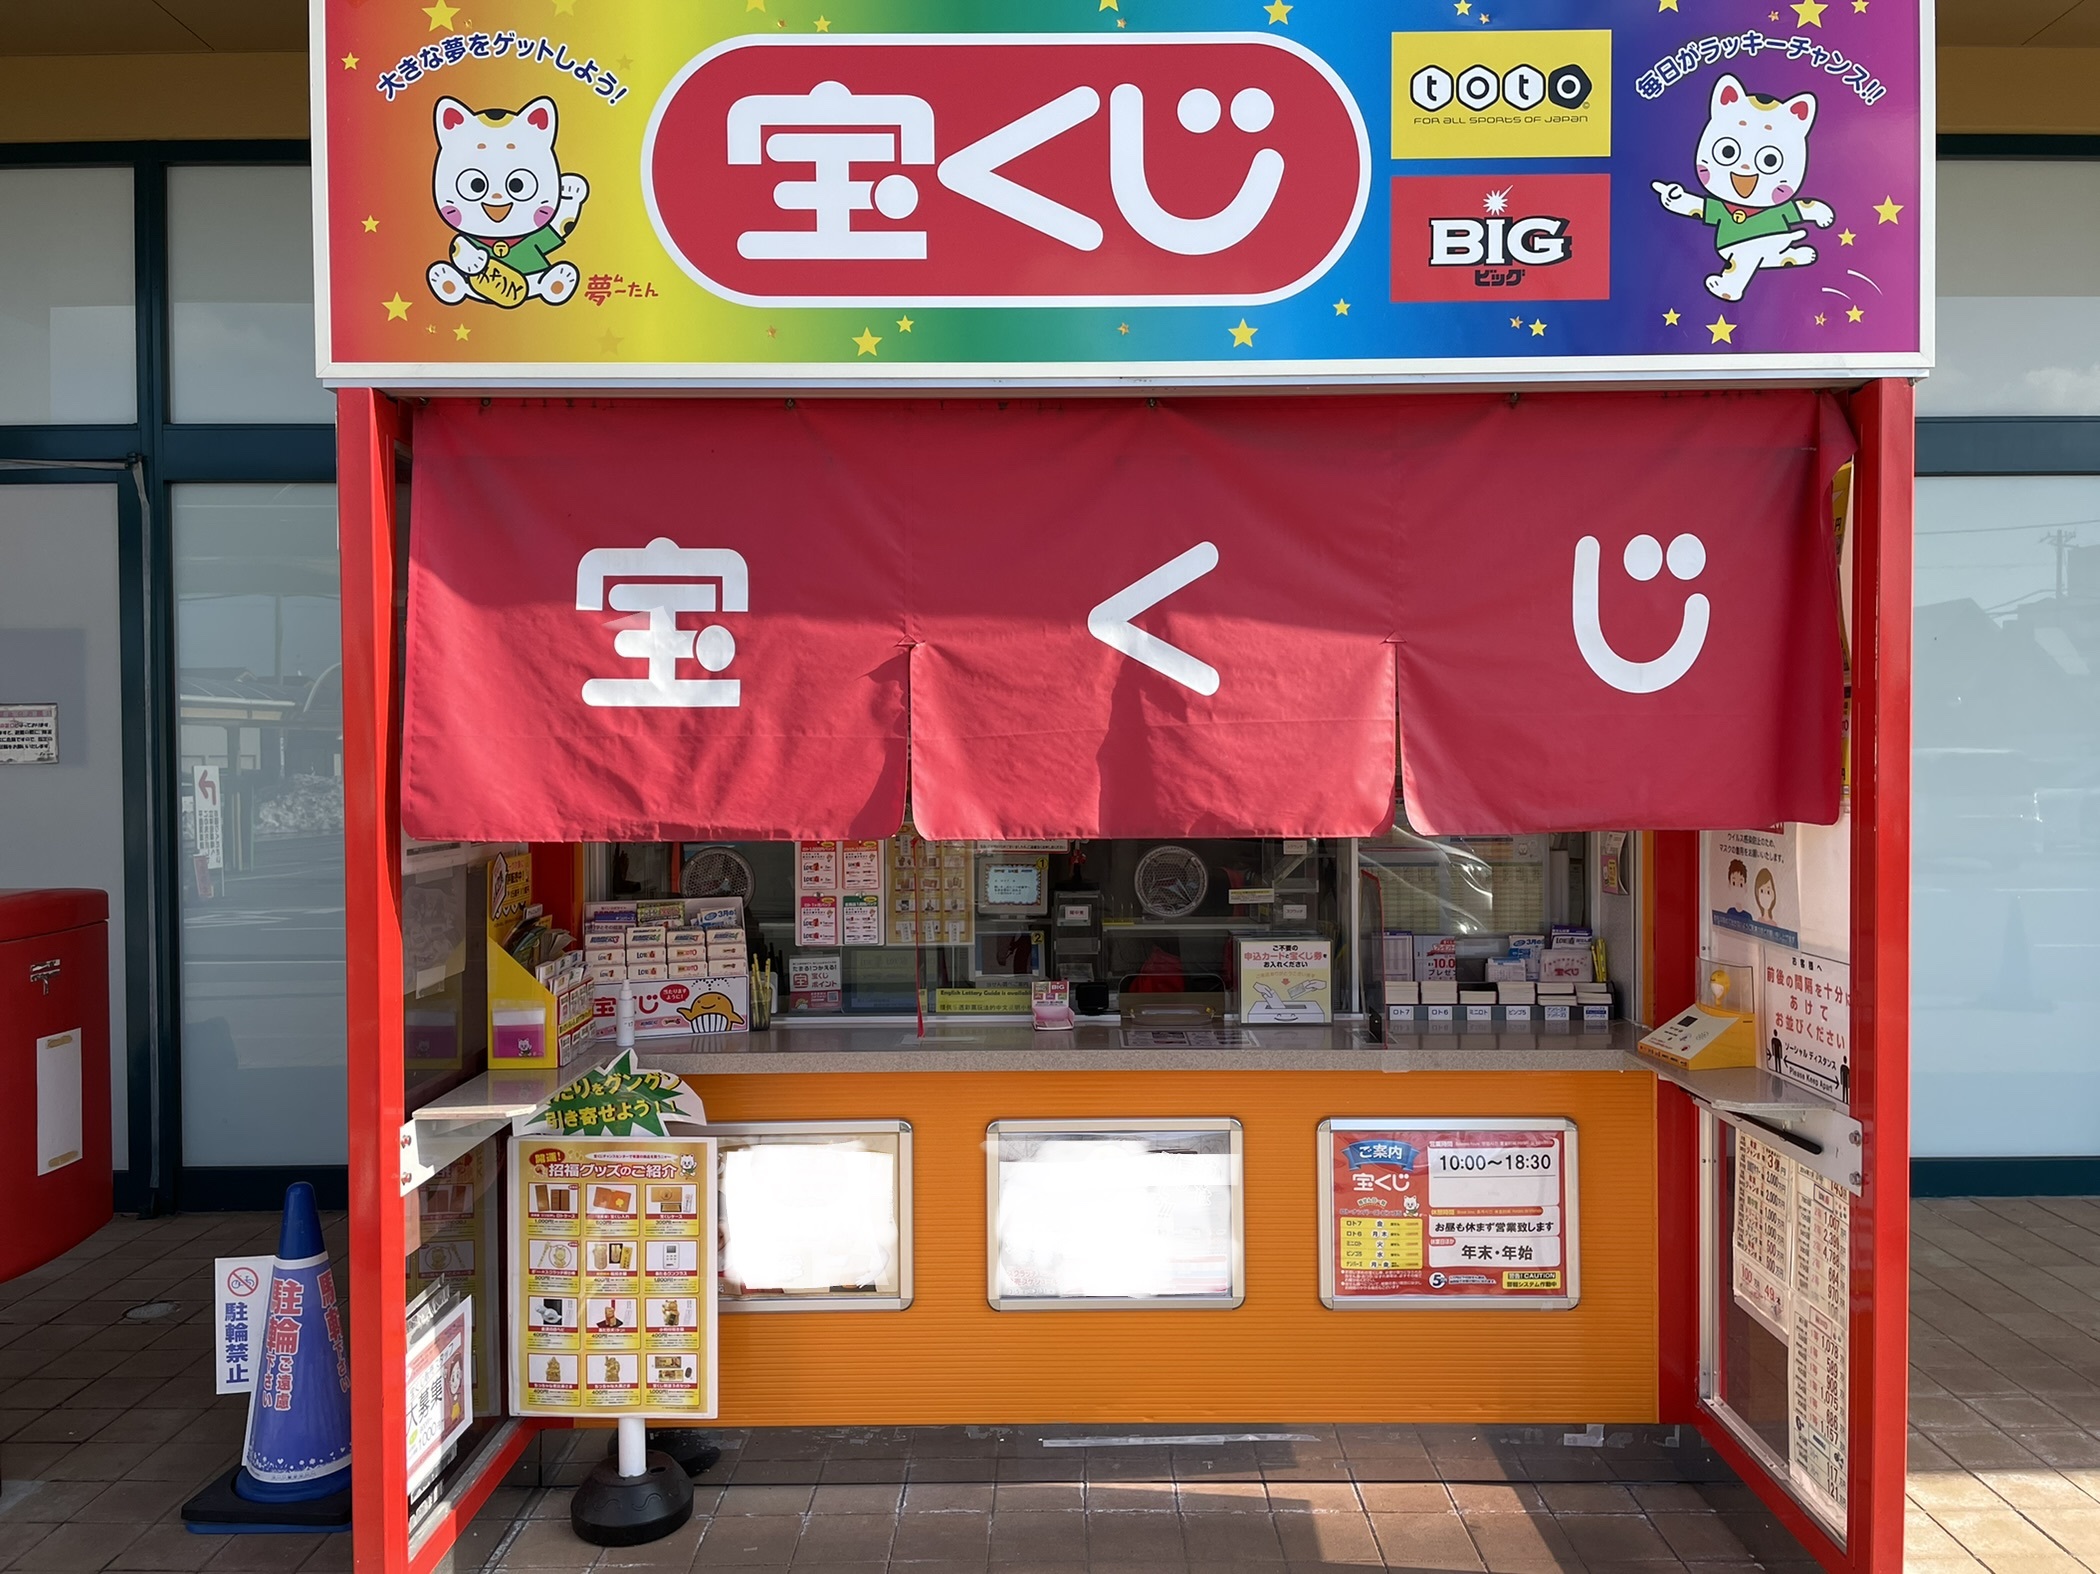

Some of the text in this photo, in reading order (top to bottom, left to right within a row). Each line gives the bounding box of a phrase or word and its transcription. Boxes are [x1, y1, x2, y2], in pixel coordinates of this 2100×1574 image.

[377, 32, 628, 106] 大きな夢をゲットしよう!
[1634, 29, 1888, 106] 毎日がラッキーチャンス!!
[1413, 66, 1590, 110] toto
[1414, 116, 1441, 125] FOR
[1524, 115, 1542, 124] OF
[726, 80, 1284, 260] 宝くじ
[1428, 216, 1572, 267] BIG
[1475, 269, 1525, 287] ビッグ
[1244, 951, 1328, 961] 申込カードと宝くじ券を
[1272, 944, 1299, 952] ご不要の
[1263, 961, 1308, 969] お入れください
[1791, 957, 1823, 972] お客様へ
[811, 972, 829, 980] 宝くじ
[811, 980, 838, 988] ポイント
[940, 989, 961, 997] English
[962, 989, 982, 997] Lottery
[594, 995, 660, 1018] 宝じ
[1789, 994, 1829, 1022] あけて
[1775, 1011, 1846, 1050] お並びください
[1784, 1041, 1837, 1071] ソーシャルディスタンス
[546, 1071, 681, 1106] たりをグングン
[1789, 1066, 1806, 1080] Please
[1820, 1080, 1834, 1094] Apart
[1359, 1143, 1403, 1160] ご案内
[548, 1163, 678, 1179] 招福グッズのご紹介
[1352, 1172, 1411, 1192] 宝くじ
[1435, 1221, 1554, 1233] お昼も休まず営業致します
[1461, 1245, 1533, 1261] 年末・年始
[224, 1301, 250, 1385] 駐輪禁止
